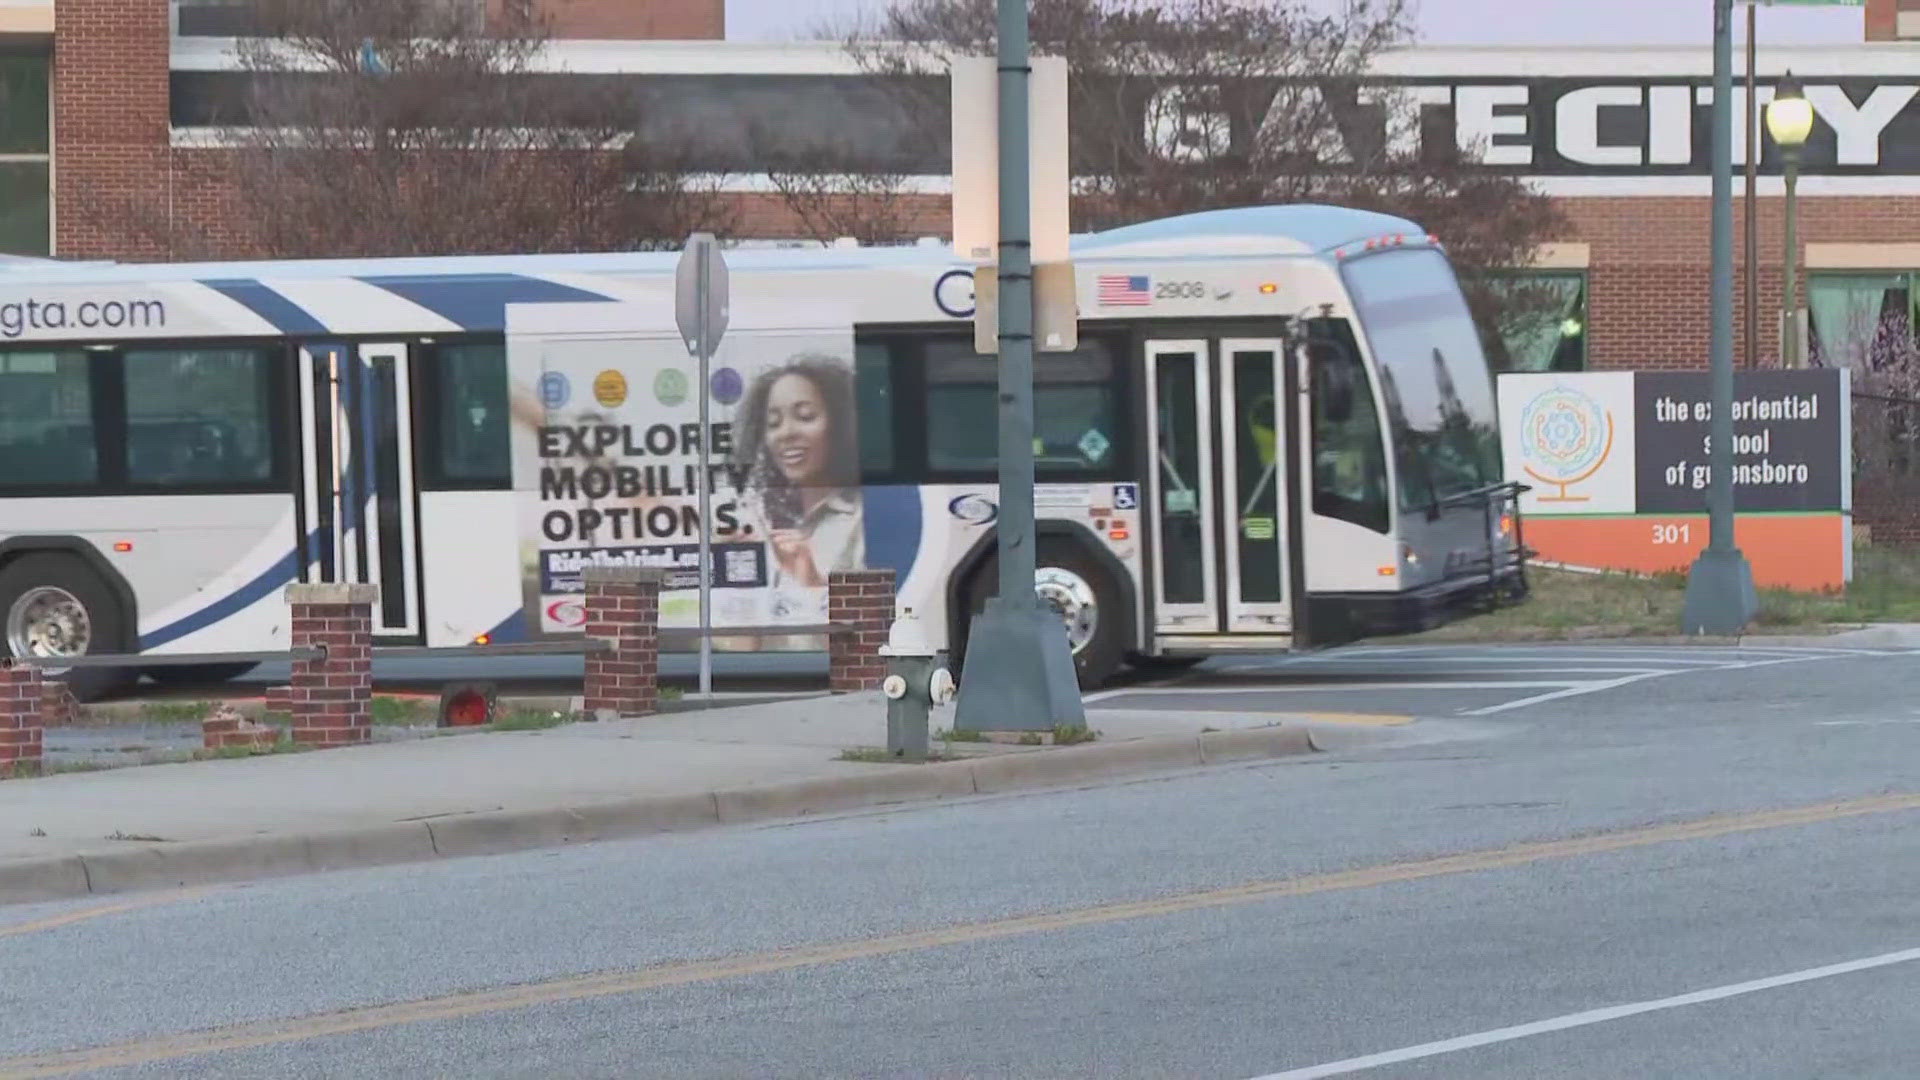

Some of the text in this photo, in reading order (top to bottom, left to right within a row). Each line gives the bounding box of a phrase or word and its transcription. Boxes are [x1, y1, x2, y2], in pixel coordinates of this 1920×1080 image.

[1142, 83, 1920, 166] GATE CITY
[0, 298, 165, 338] gta.com
[1655, 393, 1818, 422] the eeriential
[538, 422, 733, 458] EXPLORE
[1703, 428, 1769, 455] sool
[540, 463, 754, 501] MOBILITY
[1665, 458, 1809, 490] of grensboro
[542, 501, 754, 542] OPTIONS.
[1651, 523, 1690, 544] 301
